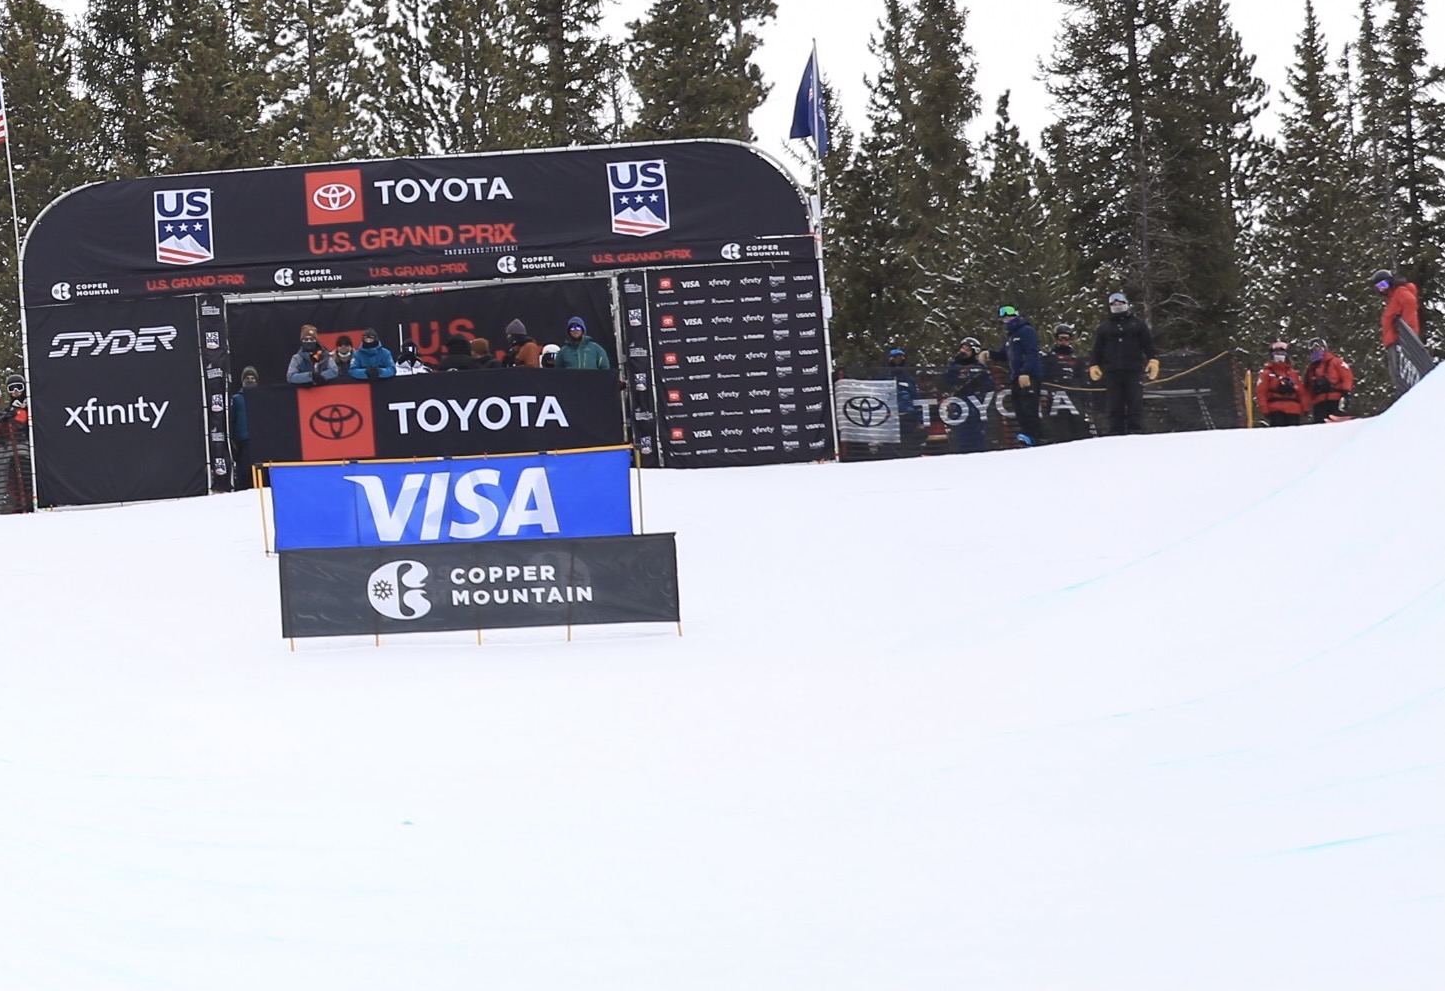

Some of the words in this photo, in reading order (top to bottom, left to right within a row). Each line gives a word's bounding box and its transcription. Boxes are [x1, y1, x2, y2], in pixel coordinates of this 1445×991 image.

[609, 162, 664, 190] US
[374, 177, 513, 204] TOYOTA
[157, 191, 209, 217] US
[309, 232, 356, 254] U.S.
[361, 225, 454, 250] GRAND
[459, 223, 517, 244] PRIX
[618, 251, 662, 263] GRAND
[664, 248, 692, 259] PRIX
[746, 244, 778, 252] COPPER
[747, 249, 789, 257] MOUNTAIN
[394, 264, 439, 276] GRAND
[441, 262, 468, 273] PRIX
[171, 275, 216, 288] GRAND
[218, 273, 245, 285] PRIX
[300, 274, 342, 282] MOUNTAIN
[681, 280, 700, 288] VISA
[76, 283, 108, 291] COPPER
[683, 318, 703, 326] VISA
[49, 326, 177, 357] SPYDER
[686, 355, 706, 363] VISA
[65, 396, 169, 432] xfinity
[389, 396, 569, 434] TOYOTA
[913, 389, 1080, 426] TOYOA
[693, 430, 712, 438] VISA
[344, 466, 559, 541] VISA
[450, 564, 555, 584] COPPER
[452, 585, 593, 606] MOUNTAIN
